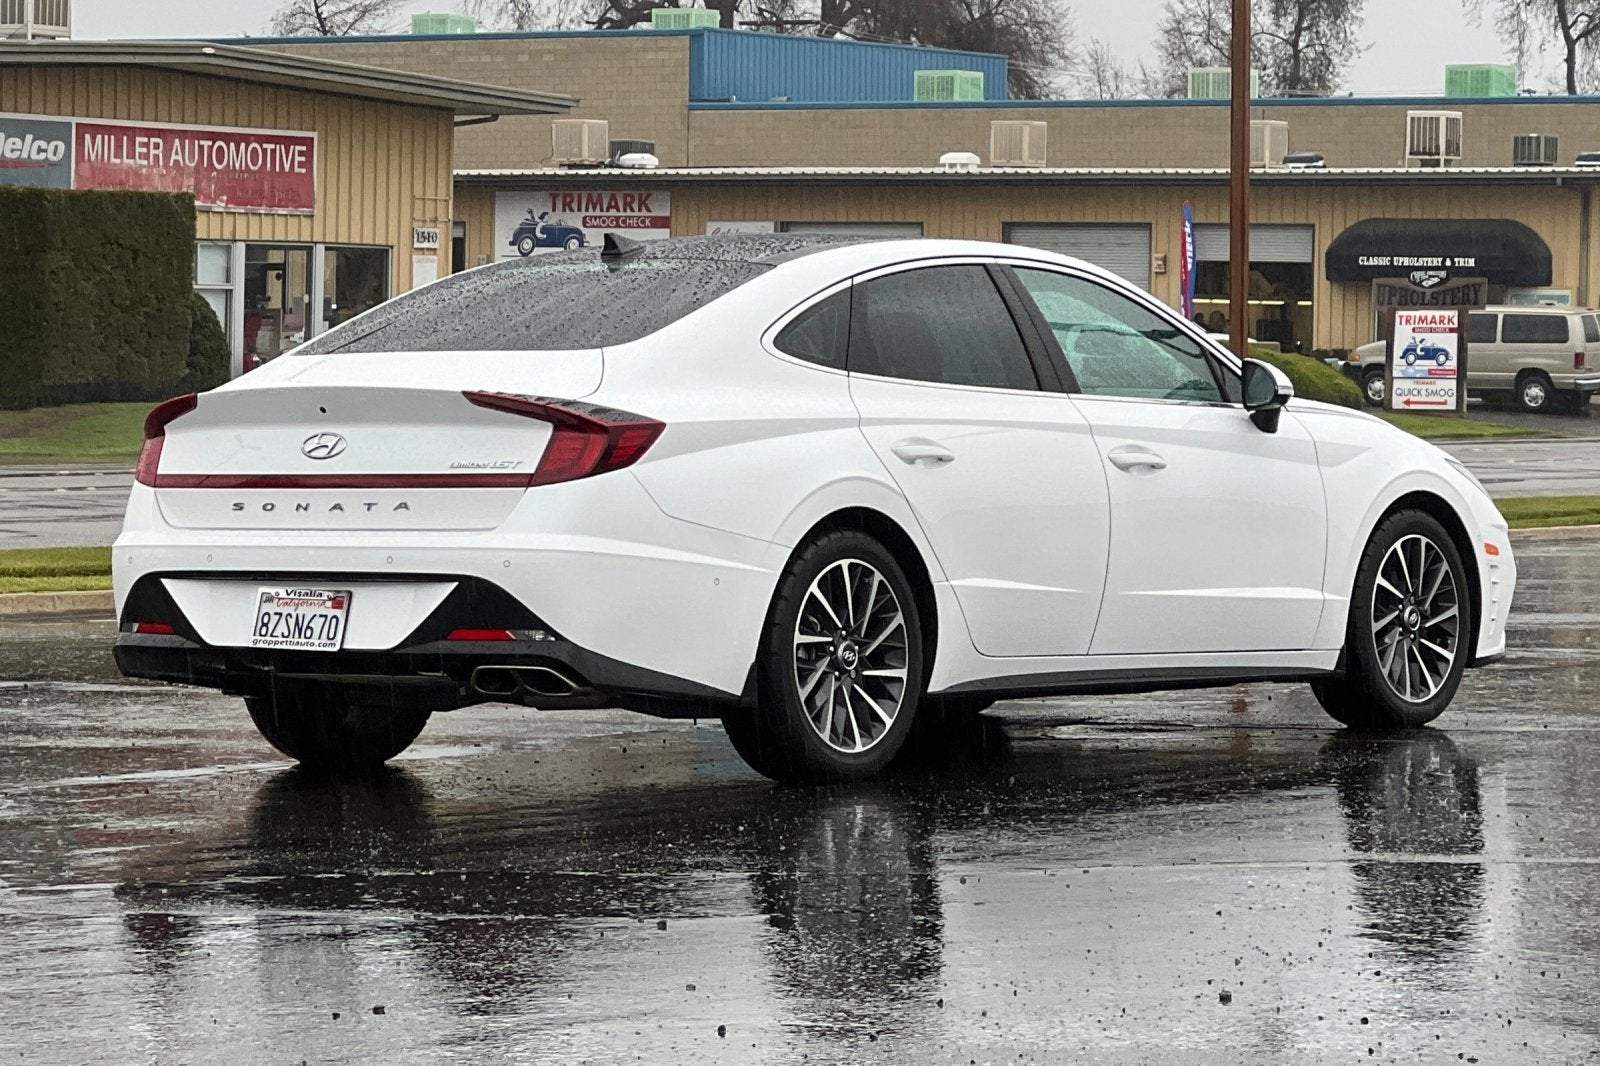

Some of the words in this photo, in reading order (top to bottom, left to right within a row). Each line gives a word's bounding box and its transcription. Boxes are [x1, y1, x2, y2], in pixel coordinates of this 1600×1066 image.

[84, 132, 163, 167] MILLER
[169, 138, 308, 174] AUTOMOTIVE
[550, 192, 653, 213] TRIMARK
[585, 216, 616, 227] SMOG
[618, 216, 652, 228] CHECK
[1358, 256, 1391, 266] CLASSIC
[1393, 257, 1443, 267] UPHOLSTERY
[1445, 257, 1452, 266] &
[1454, 257, 1476, 267] TRIM
[1375, 283, 1482, 306] UPHOLSTERY
[1398, 314, 1456, 326] TRIMARK
[1394, 388, 1423, 398] QUICK
[1425, 388, 1455, 398] SMOG
[231, 502, 411, 512] SONATA
[285, 589, 323, 598] Visalia
[276, 599, 332, 612] California
[258, 611, 340, 641] 8ZSN670
[252, 638, 337, 649] groppettiauto.com
